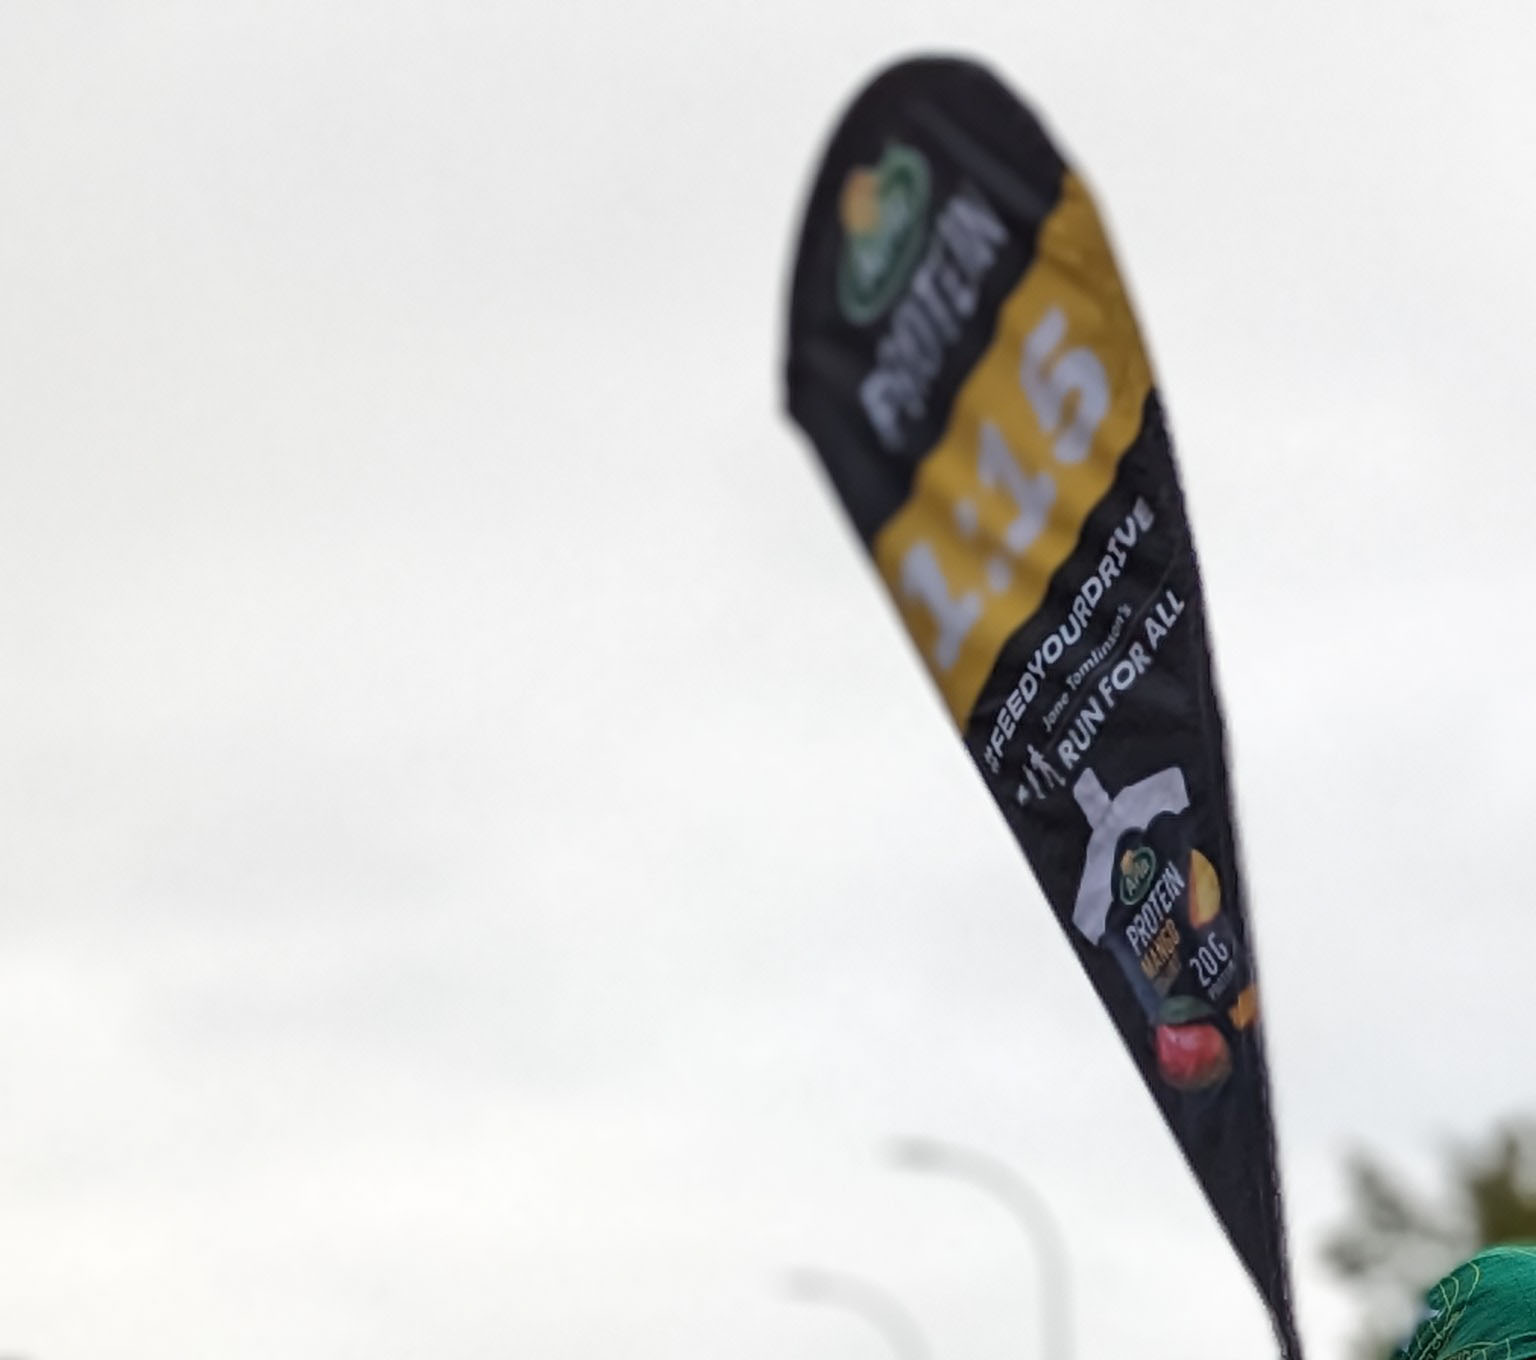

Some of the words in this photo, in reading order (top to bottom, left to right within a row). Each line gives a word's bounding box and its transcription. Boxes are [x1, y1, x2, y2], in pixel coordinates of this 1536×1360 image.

[1058, 697, 1106, 770] RUN
[1100, 642, 1151, 706] FOR
[1143, 589, 1185, 650] ALL
[1125, 860, 1186, 957] PROTEIN
